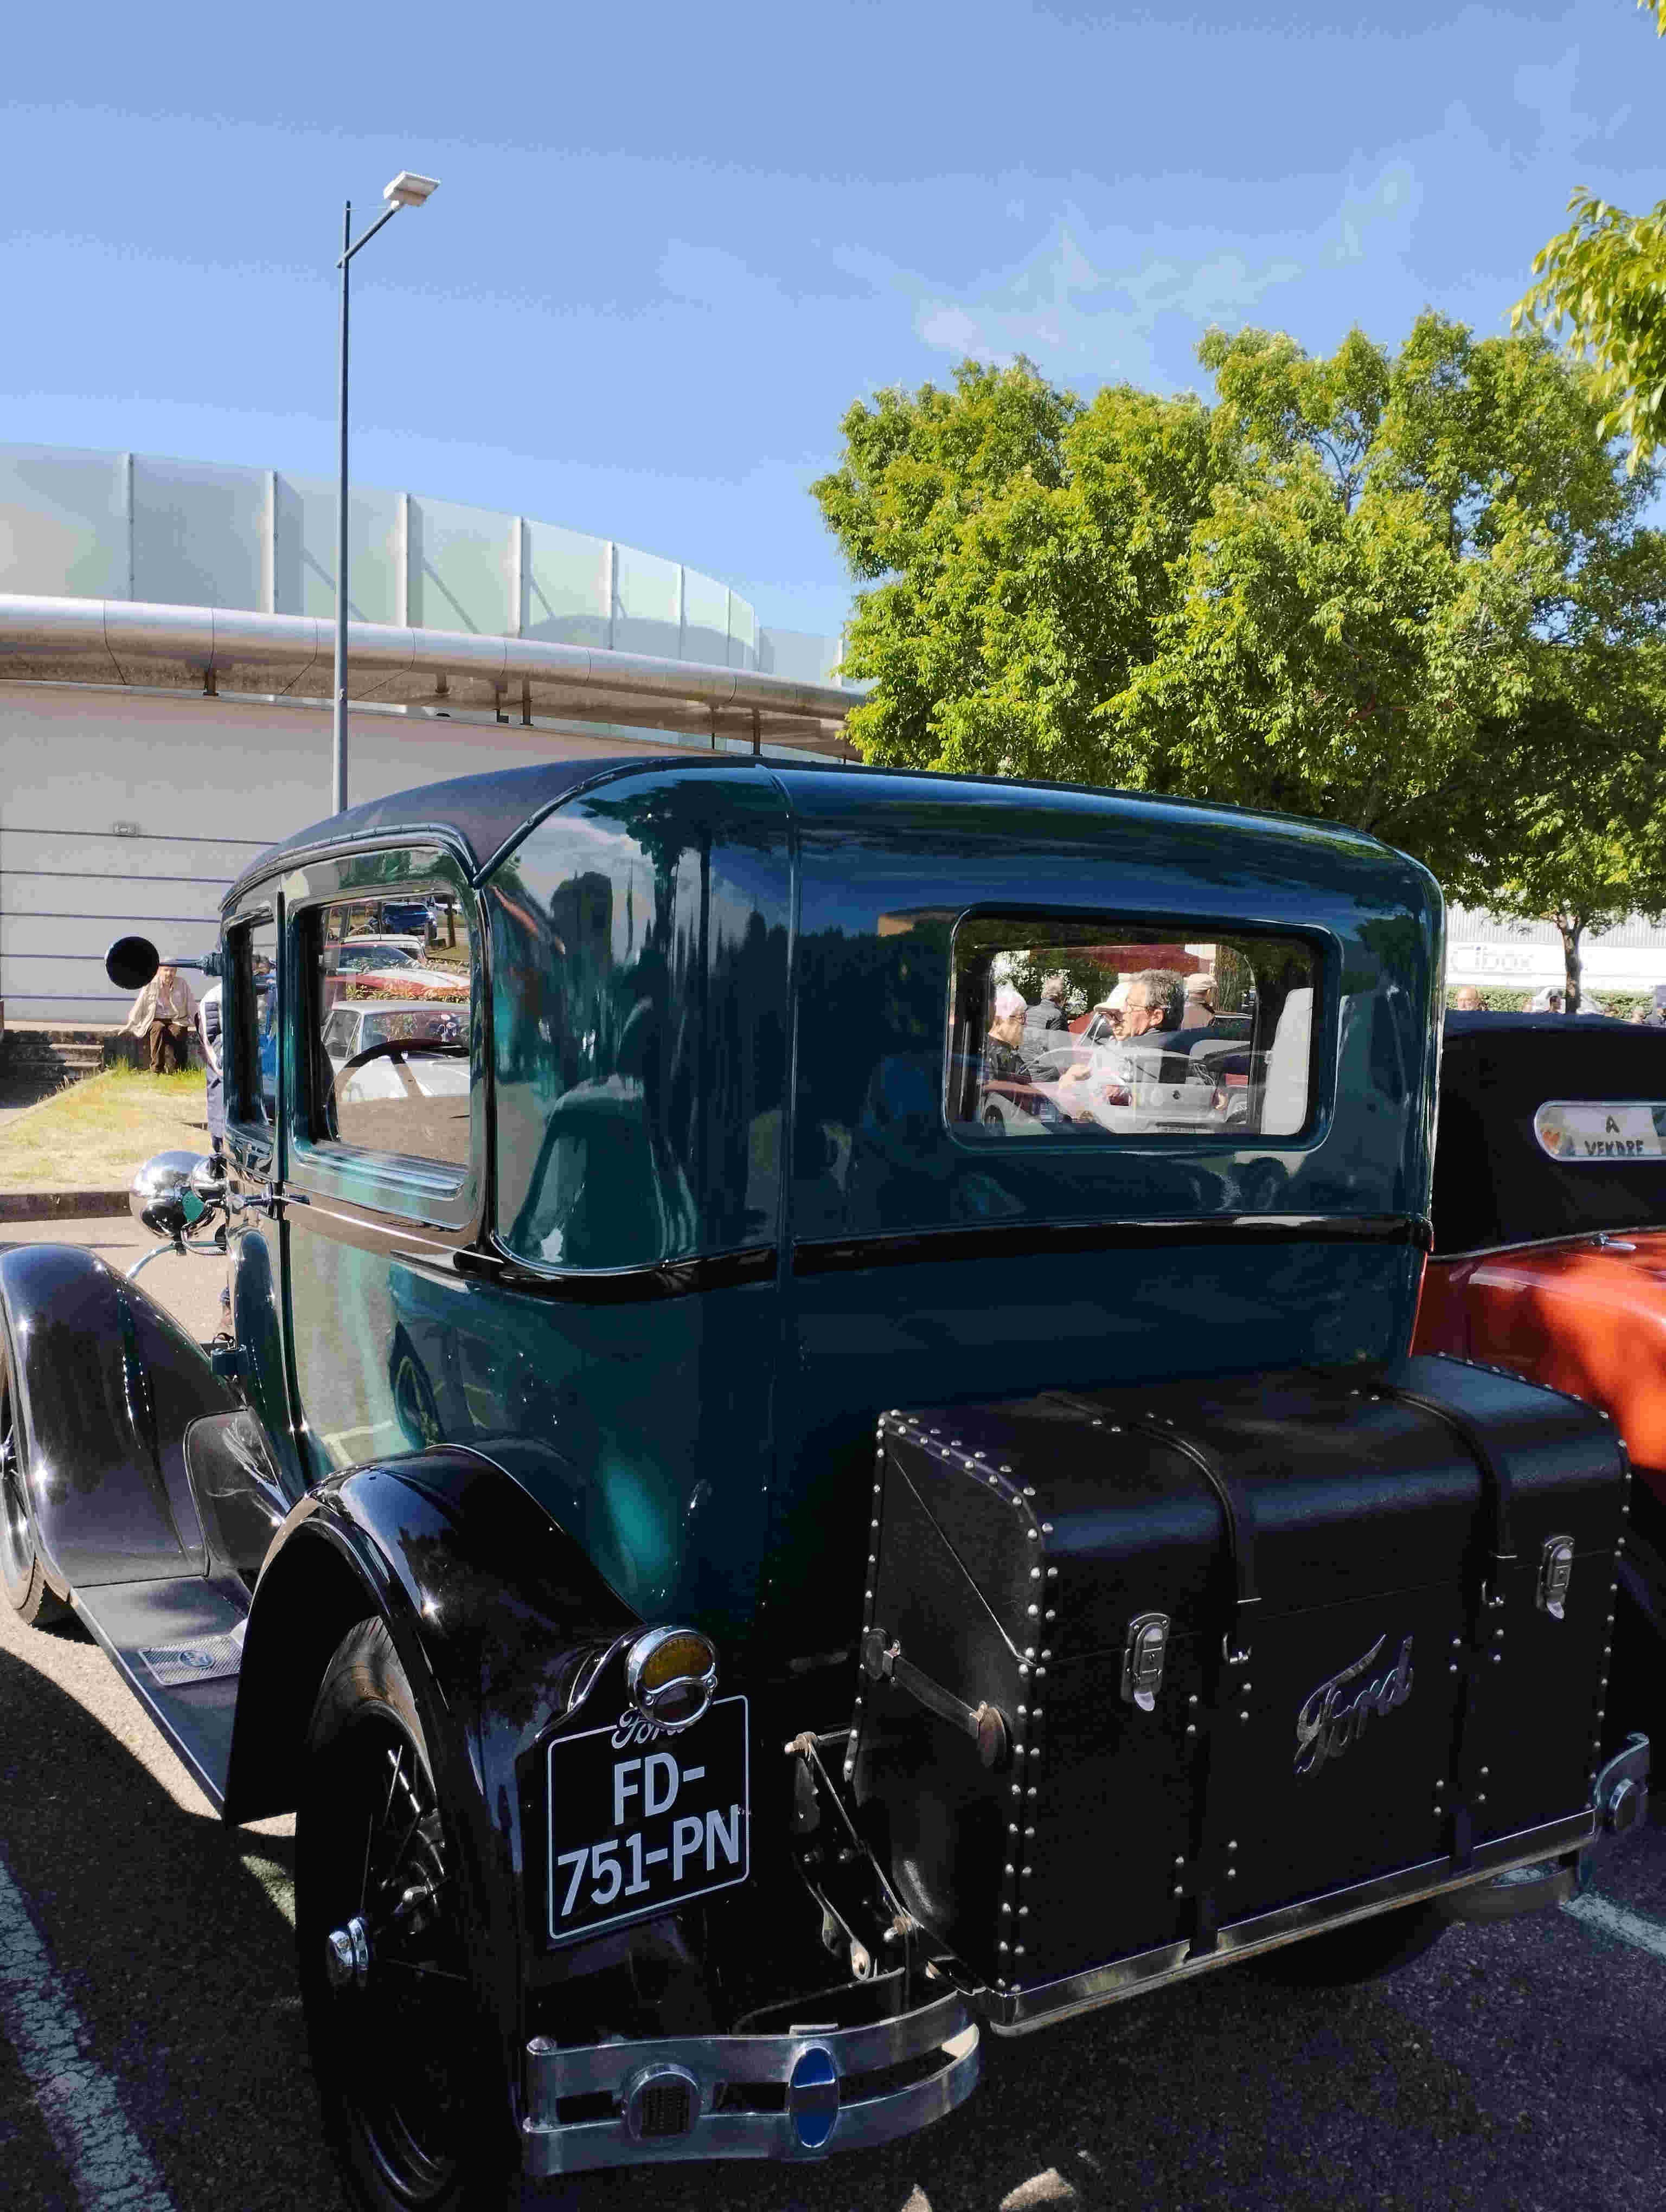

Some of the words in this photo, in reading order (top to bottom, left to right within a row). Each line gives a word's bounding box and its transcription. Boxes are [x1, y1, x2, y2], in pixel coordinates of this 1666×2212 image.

[1605, 1115, 1620, 1134] A
[1295, 1634, 1414, 1777] Ford
[614, 1753, 705, 1825] FD-
[558, 1805, 739, 1916] 751-PN
